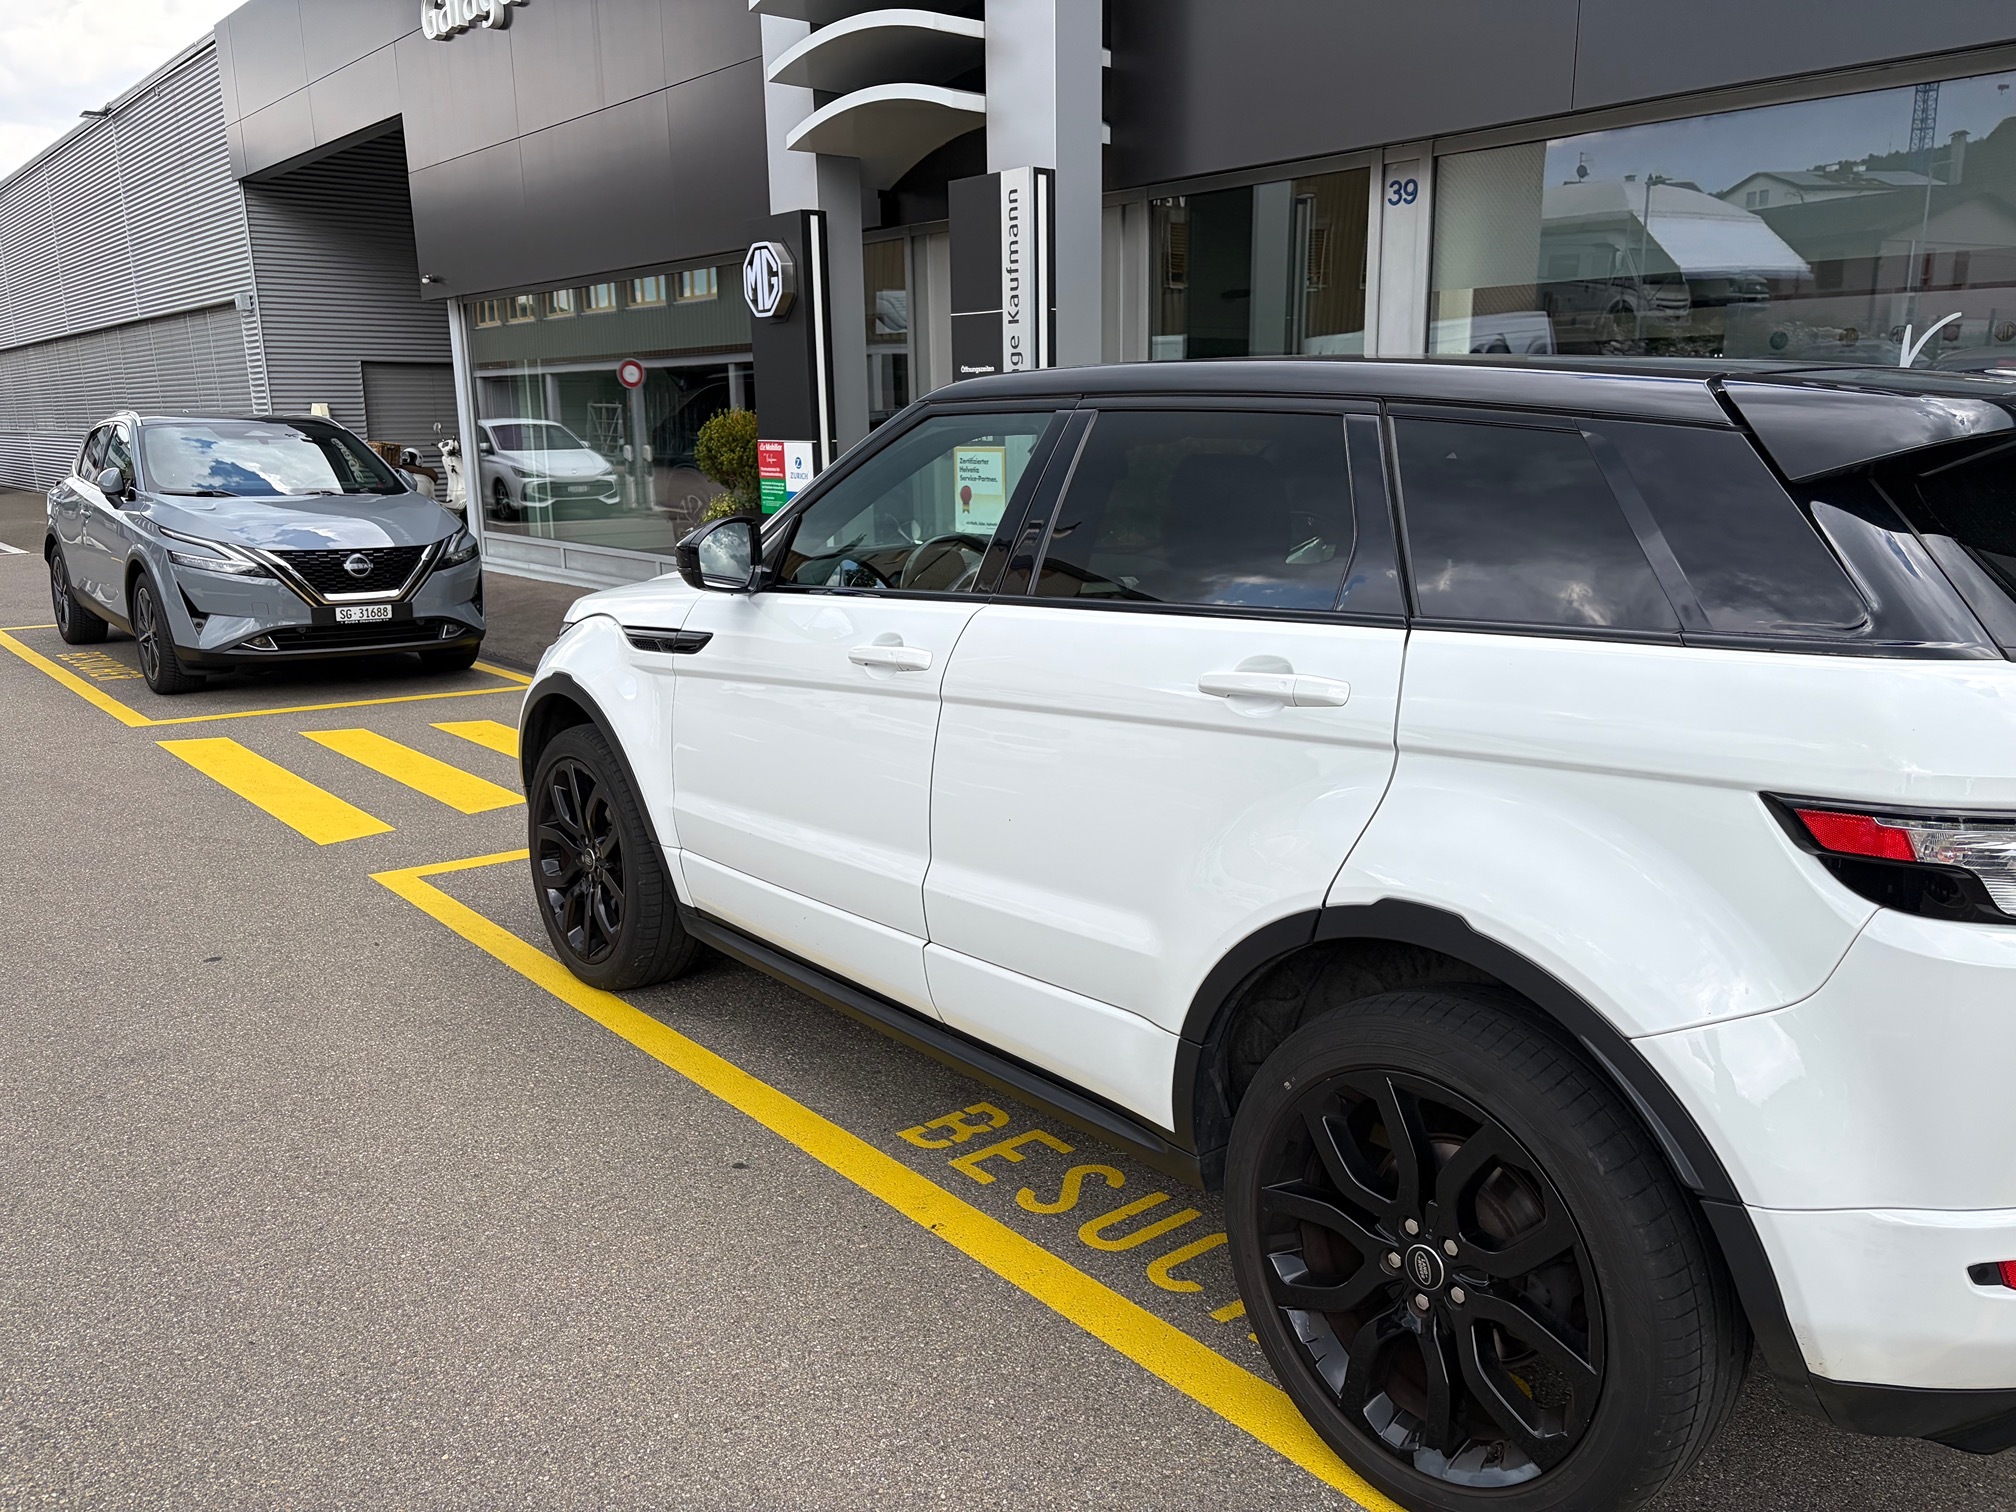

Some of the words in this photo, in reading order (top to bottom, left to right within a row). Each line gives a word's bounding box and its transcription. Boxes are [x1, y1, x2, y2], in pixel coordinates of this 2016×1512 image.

[421, 0, 519, 39] Garag
[1387, 178, 1418, 206] 39
[1005, 188, 1020, 325] Kaufmann
[745, 247, 779, 312] MG
[790, 471, 809, 480] ZURICH
[959, 466, 980, 474] Helvetia
